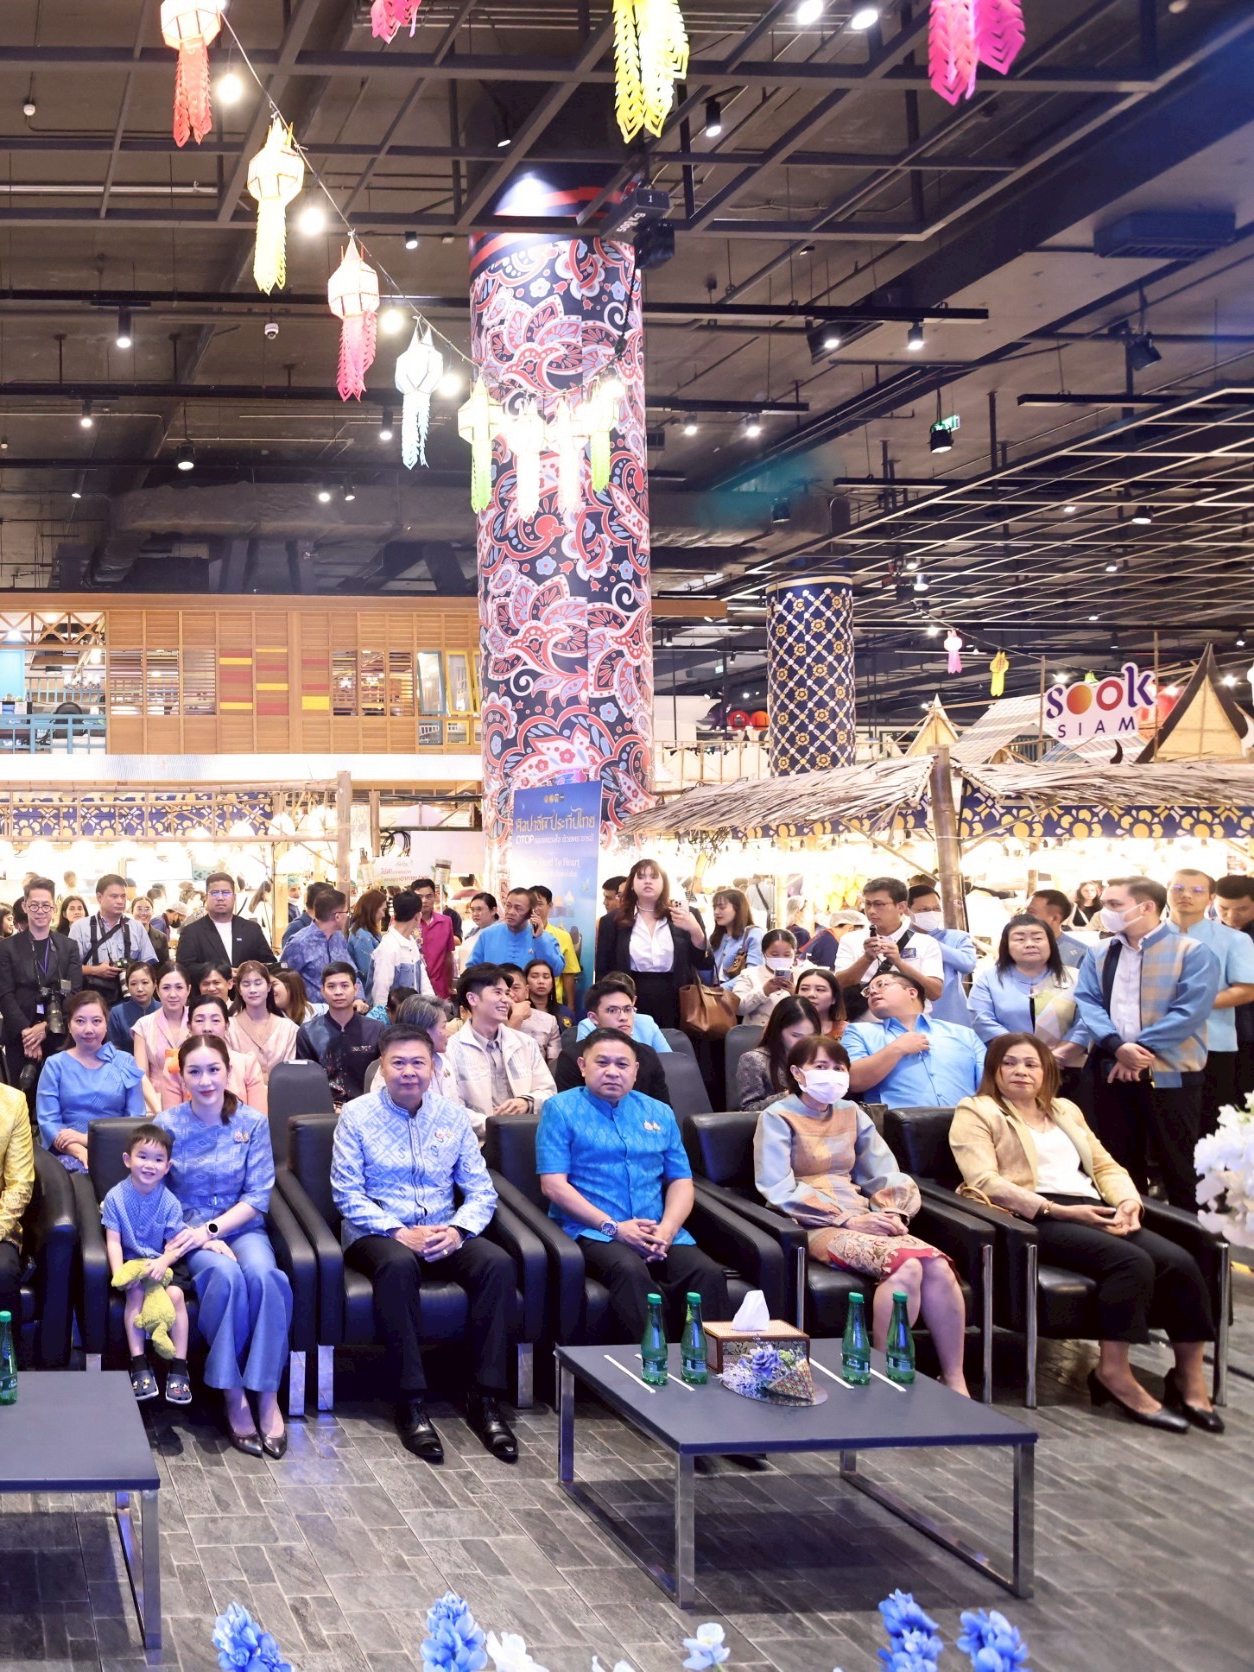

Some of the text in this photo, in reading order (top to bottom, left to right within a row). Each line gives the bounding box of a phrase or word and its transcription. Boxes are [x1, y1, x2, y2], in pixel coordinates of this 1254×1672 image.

[648, 195, 653, 203] 1
[1058, 716, 1135, 738] SIAM
[516, 834, 534, 844] OTOP
